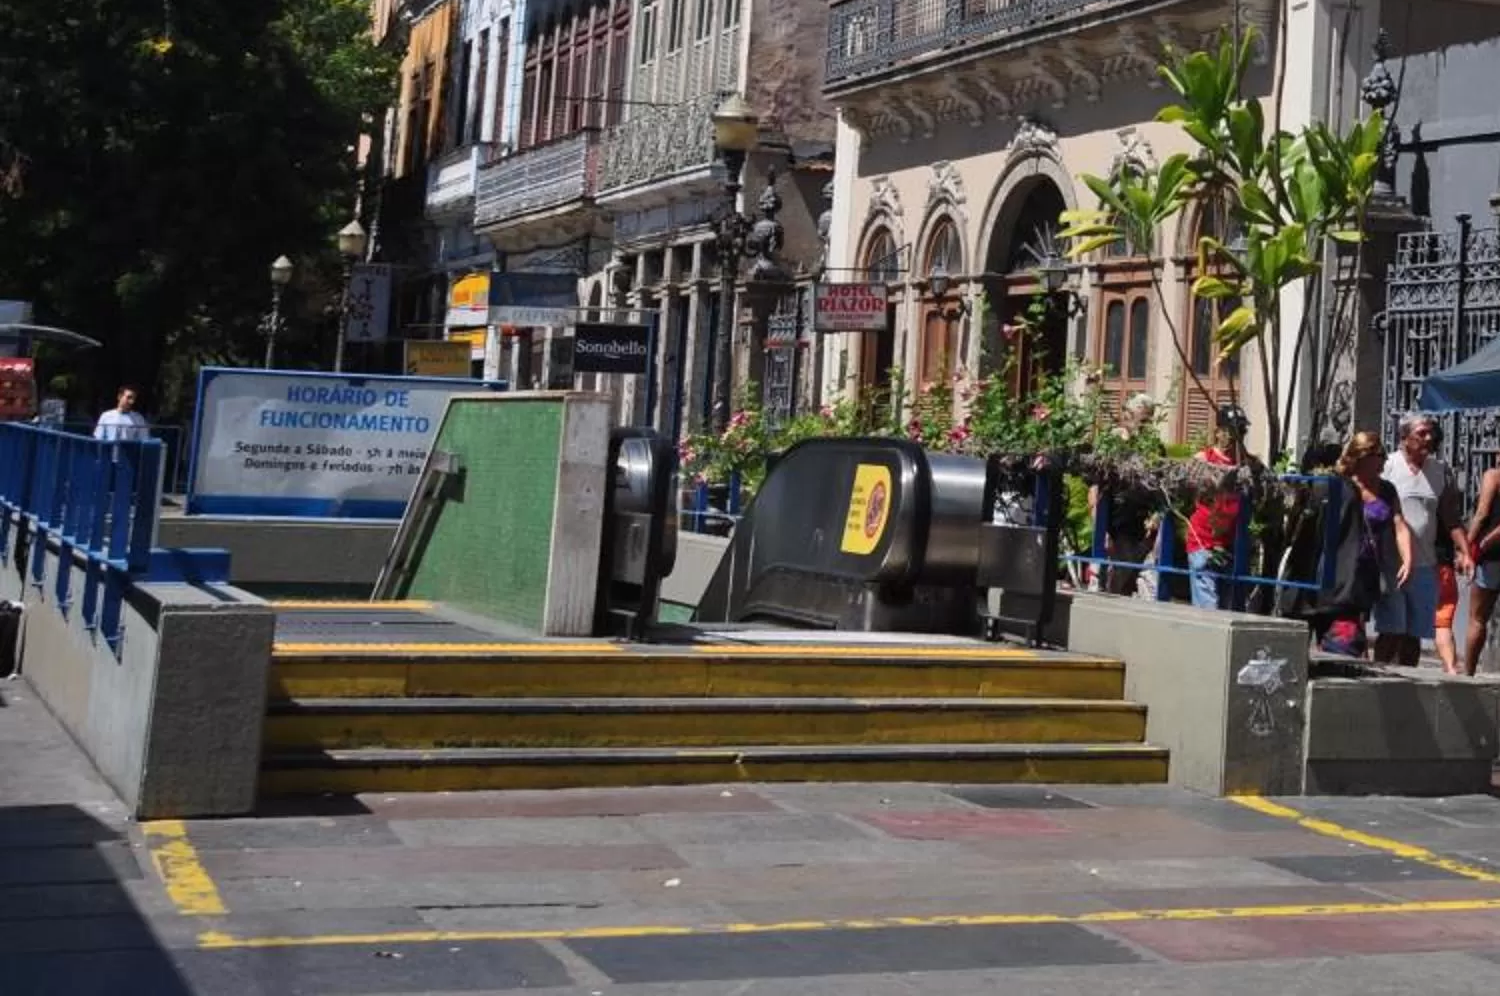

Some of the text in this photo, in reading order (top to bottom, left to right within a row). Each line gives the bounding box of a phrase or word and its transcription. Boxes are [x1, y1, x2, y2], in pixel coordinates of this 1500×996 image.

[828, 284, 875, 297] HOTEL
[287, 384, 410, 409] HORÁRIO DE
[259, 409, 430, 434] FUNCIONAMENTO
[235, 441, 290, 456] Segunda
[294, 445, 301, 455] a
[306, 443, 353, 457] Sábado
[243, 457, 305, 473] Domingos
[322, 460, 374, 473] feriados
